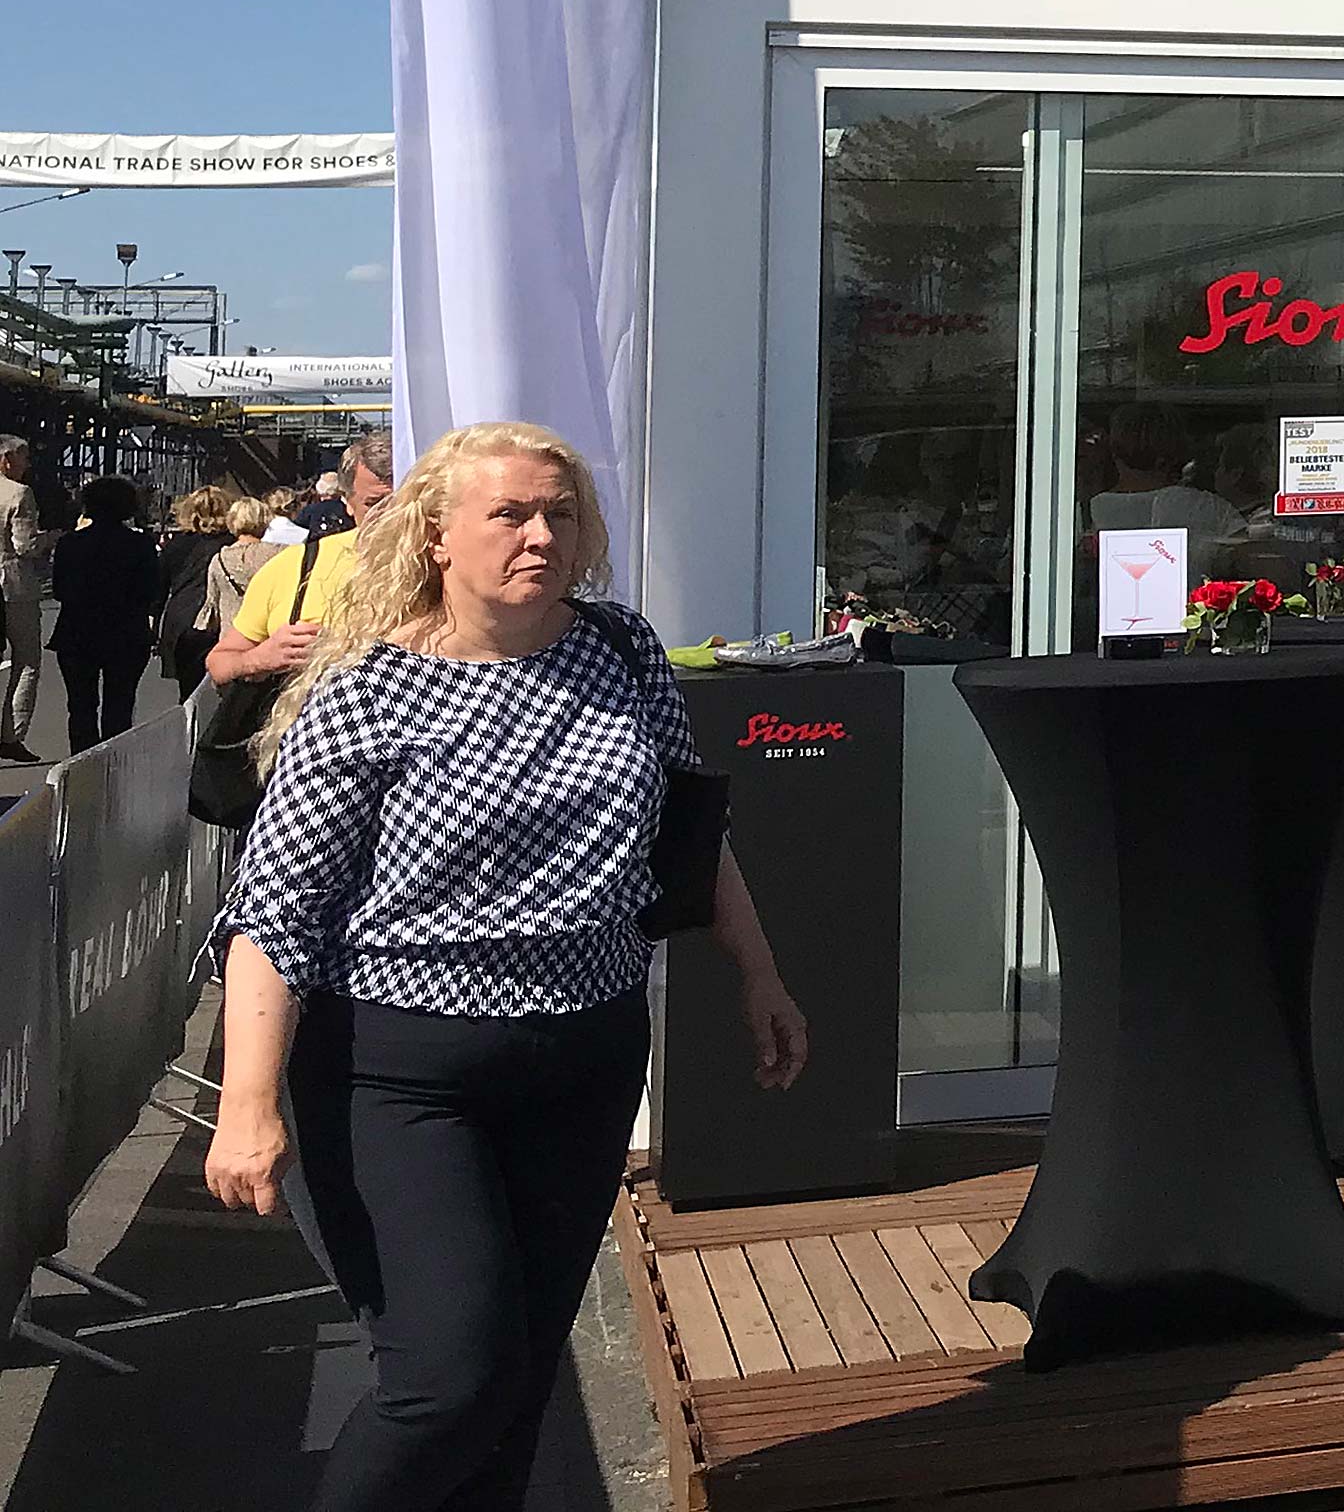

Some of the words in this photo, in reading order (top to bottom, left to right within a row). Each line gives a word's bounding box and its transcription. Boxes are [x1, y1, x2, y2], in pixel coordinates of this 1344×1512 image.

[114, 157, 181, 170] TRADE
[190, 157, 255, 171] SHOW
[263, 157, 303, 170] FOR
[311, 155, 378, 169] SHOES
[290, 363, 384, 373] INTERNATIONAL
[323, 377, 362, 386] SHOES
[1286, 428, 1314, 437] TEST
[737, 713, 847, 747] Sioux
[765, 748, 795, 758] SEIT
